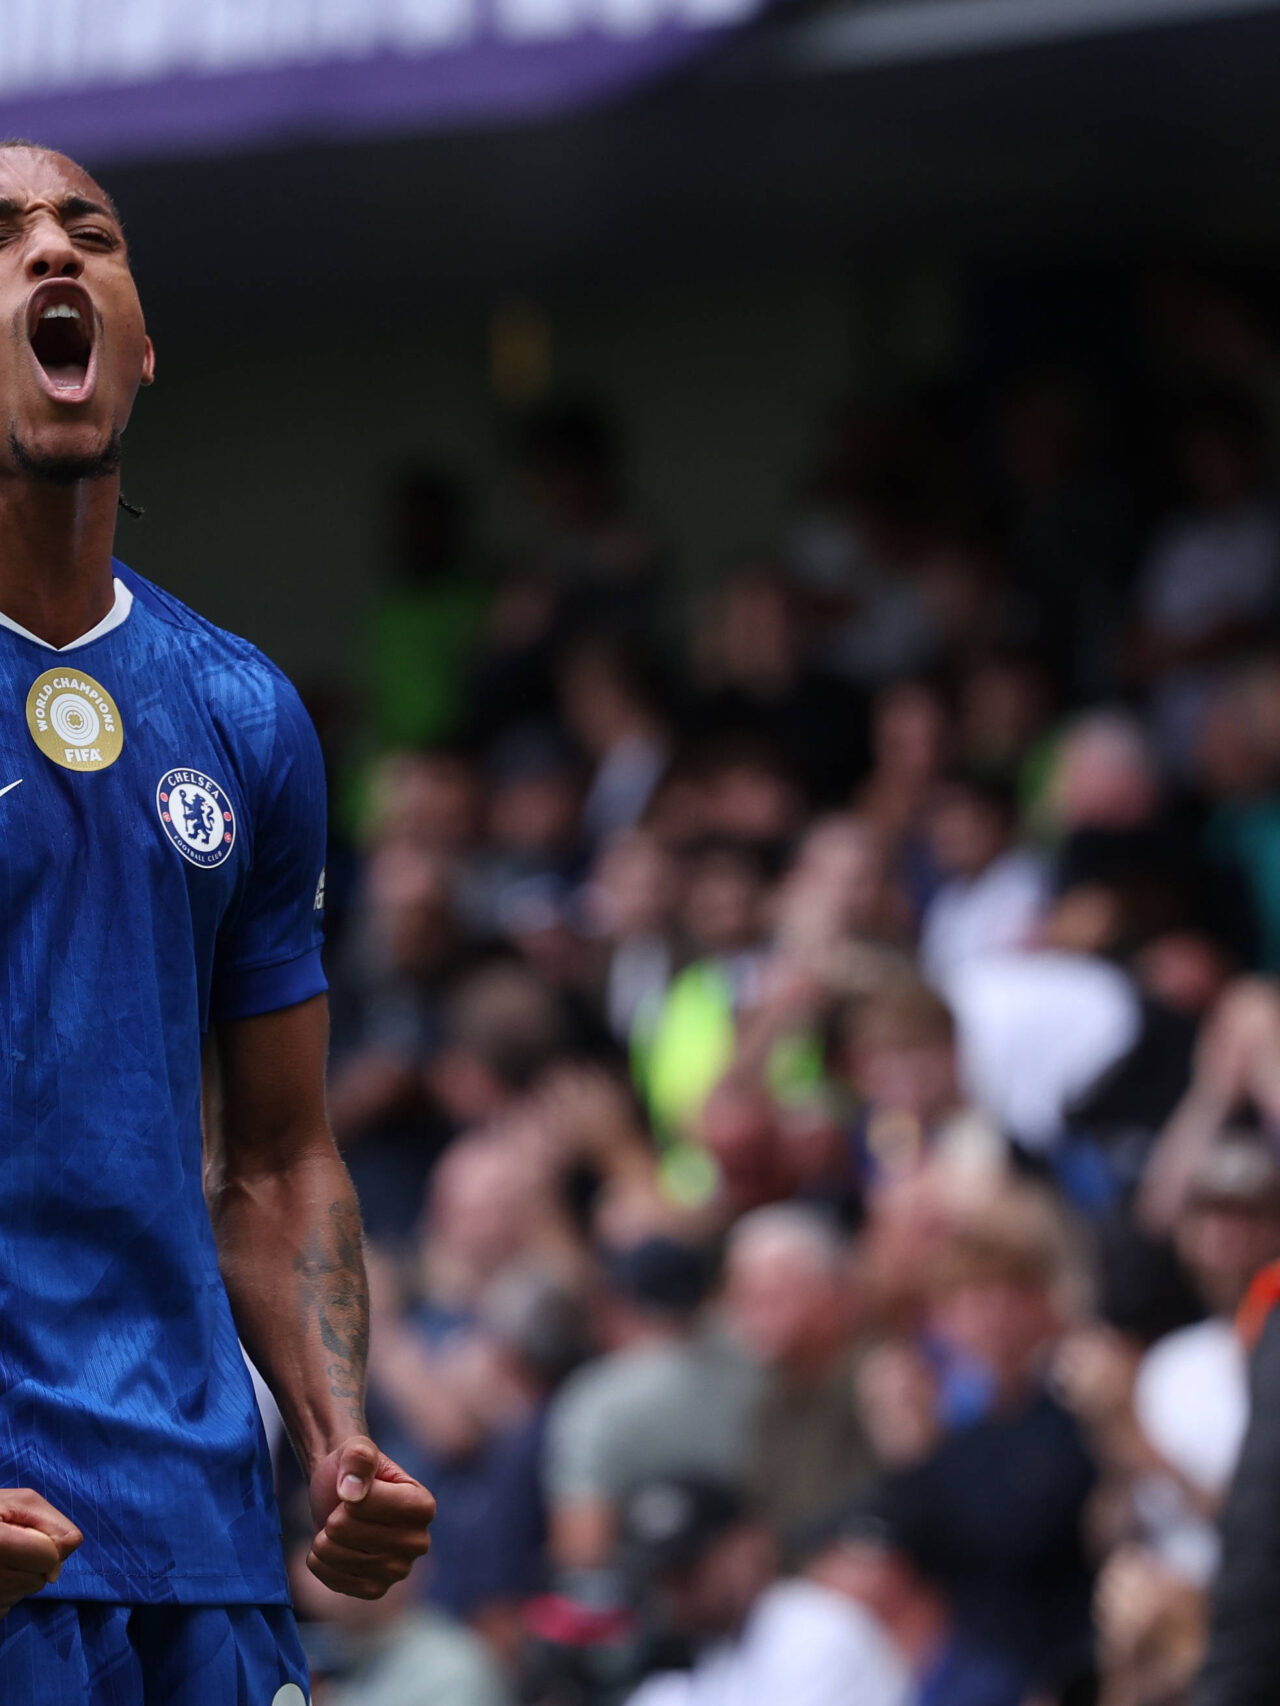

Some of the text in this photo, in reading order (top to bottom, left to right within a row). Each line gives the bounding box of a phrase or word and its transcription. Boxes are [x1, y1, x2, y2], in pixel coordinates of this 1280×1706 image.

[35, 677, 115, 732] WORLD CHAMPIONS
[64, 748, 103, 763] FIFA
[167, 772, 219, 799] CHELSEA
[173, 835, 222, 862] FOOTBALL CLUB
